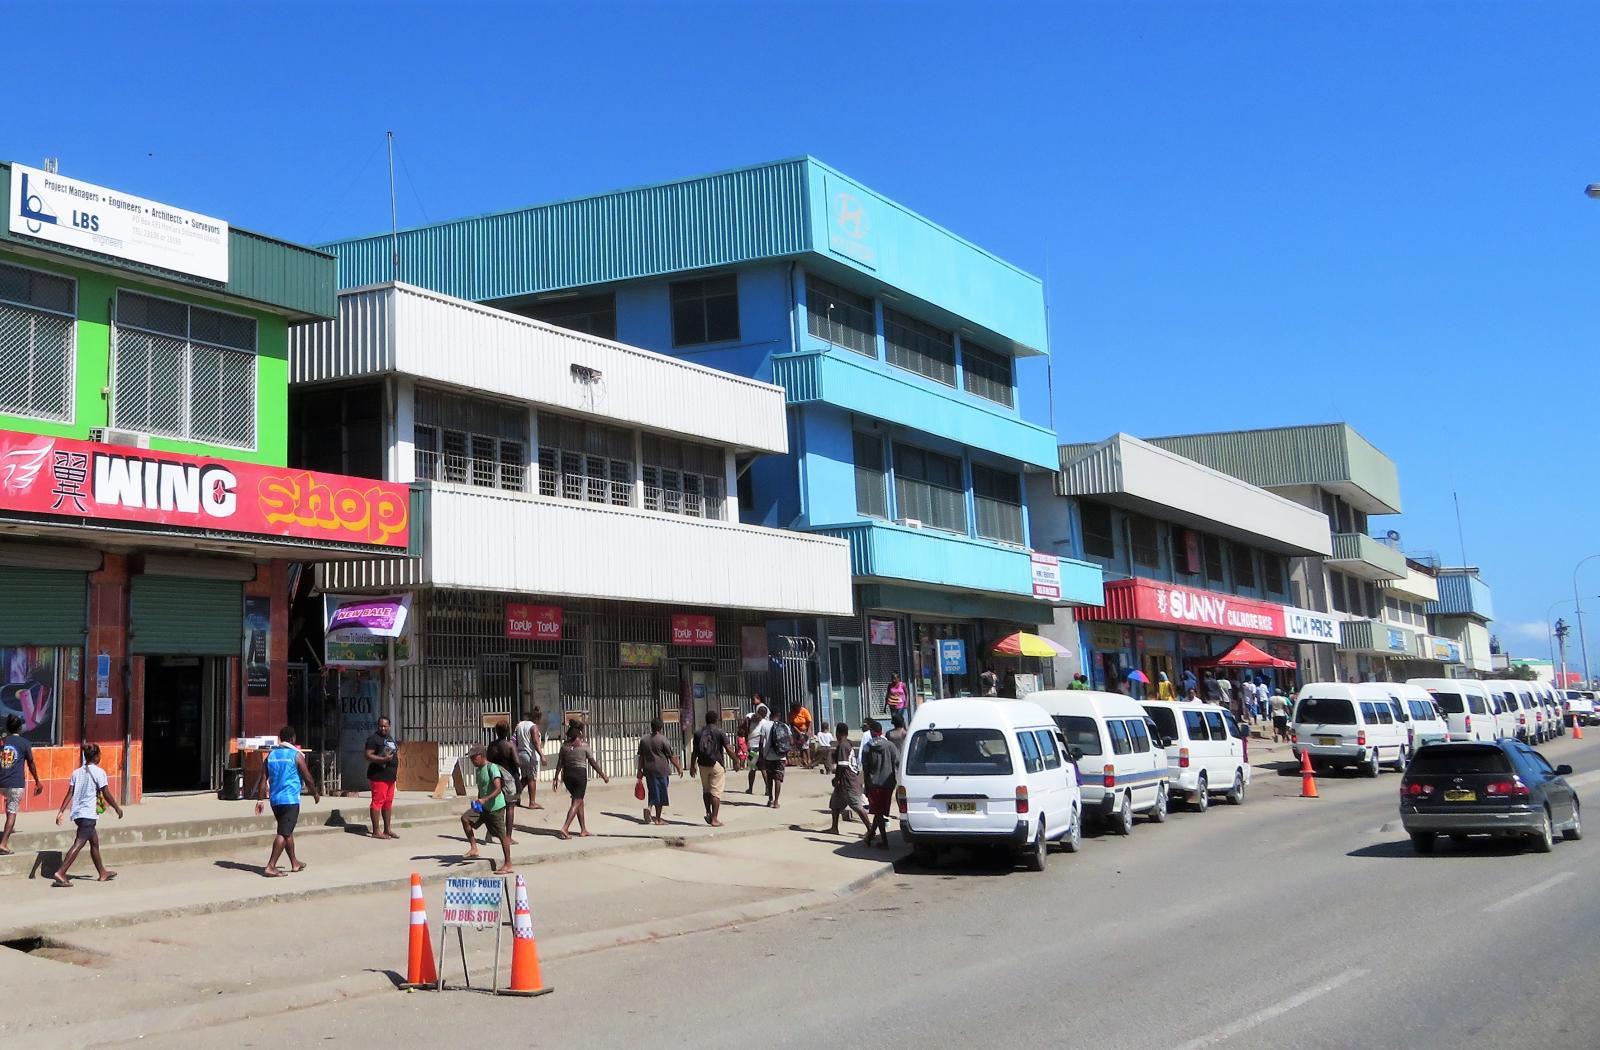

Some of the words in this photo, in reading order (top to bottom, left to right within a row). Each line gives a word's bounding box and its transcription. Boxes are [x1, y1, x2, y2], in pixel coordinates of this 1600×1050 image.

[44, 179, 67, 194] Project
[69, 185, 99, 202] Managers
[108, 196, 142, 214] Engineers
[151, 207, 183, 225] Architects
[191, 218, 220, 235] Surveyors
[72, 209, 99, 232] LBS
[337, 608, 361, 620] NEW
[361, 607, 392, 617] BALE
[1170, 590, 1227, 625] SUNNY
[1290, 615, 1309, 634] LOW
[1311, 617, 1333, 637] PRICE
[448, 879, 478, 888] TRAFFIC
[478, 879, 501, 888] POLICE
[444, 909, 456, 921] NO
[459, 910, 475, 921] BUS
[477, 910, 499, 922] STOP
